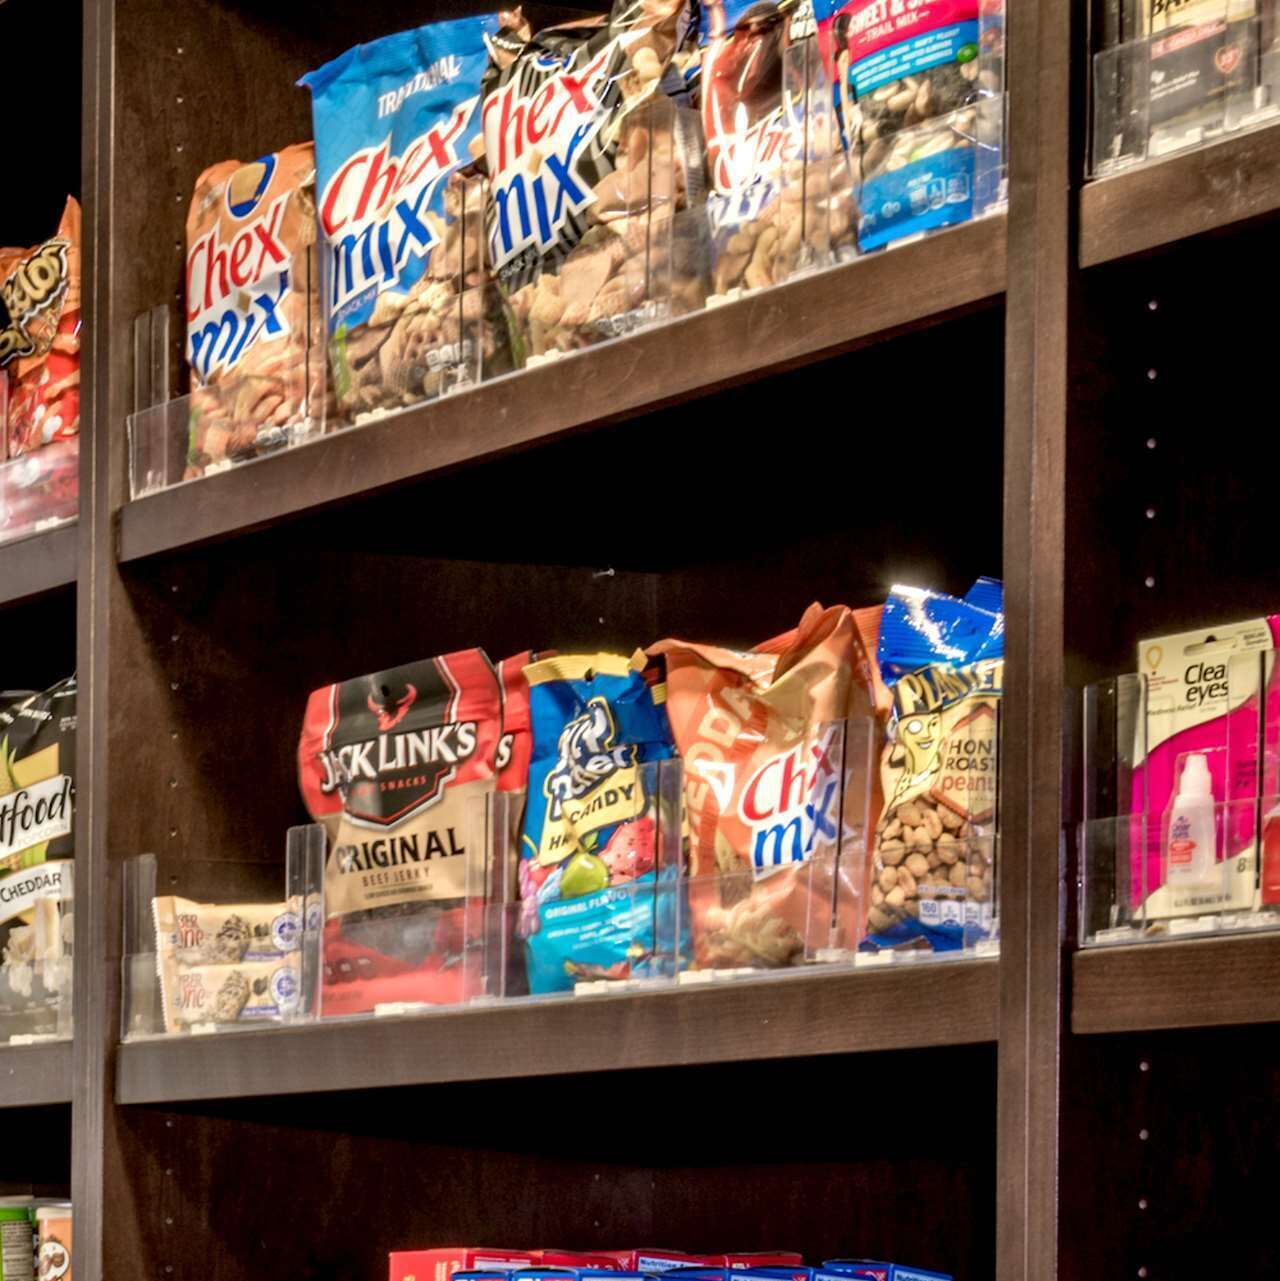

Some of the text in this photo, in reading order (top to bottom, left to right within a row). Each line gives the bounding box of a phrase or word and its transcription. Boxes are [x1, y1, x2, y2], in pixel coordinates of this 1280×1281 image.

[896, 13, 919, 29] MIX
[322, 105, 470, 238] Chex
[1183, 662, 1228, 685] Clea
[1185, 684, 1229, 706] eyes
[378, 721, 477, 772] LINK'S
[948, 738, 993, 755] HON
[569, 782, 635, 825] CANDY
[0, 872, 62, 903] CHEDDAR
[362, 871, 390, 888] BEEF
